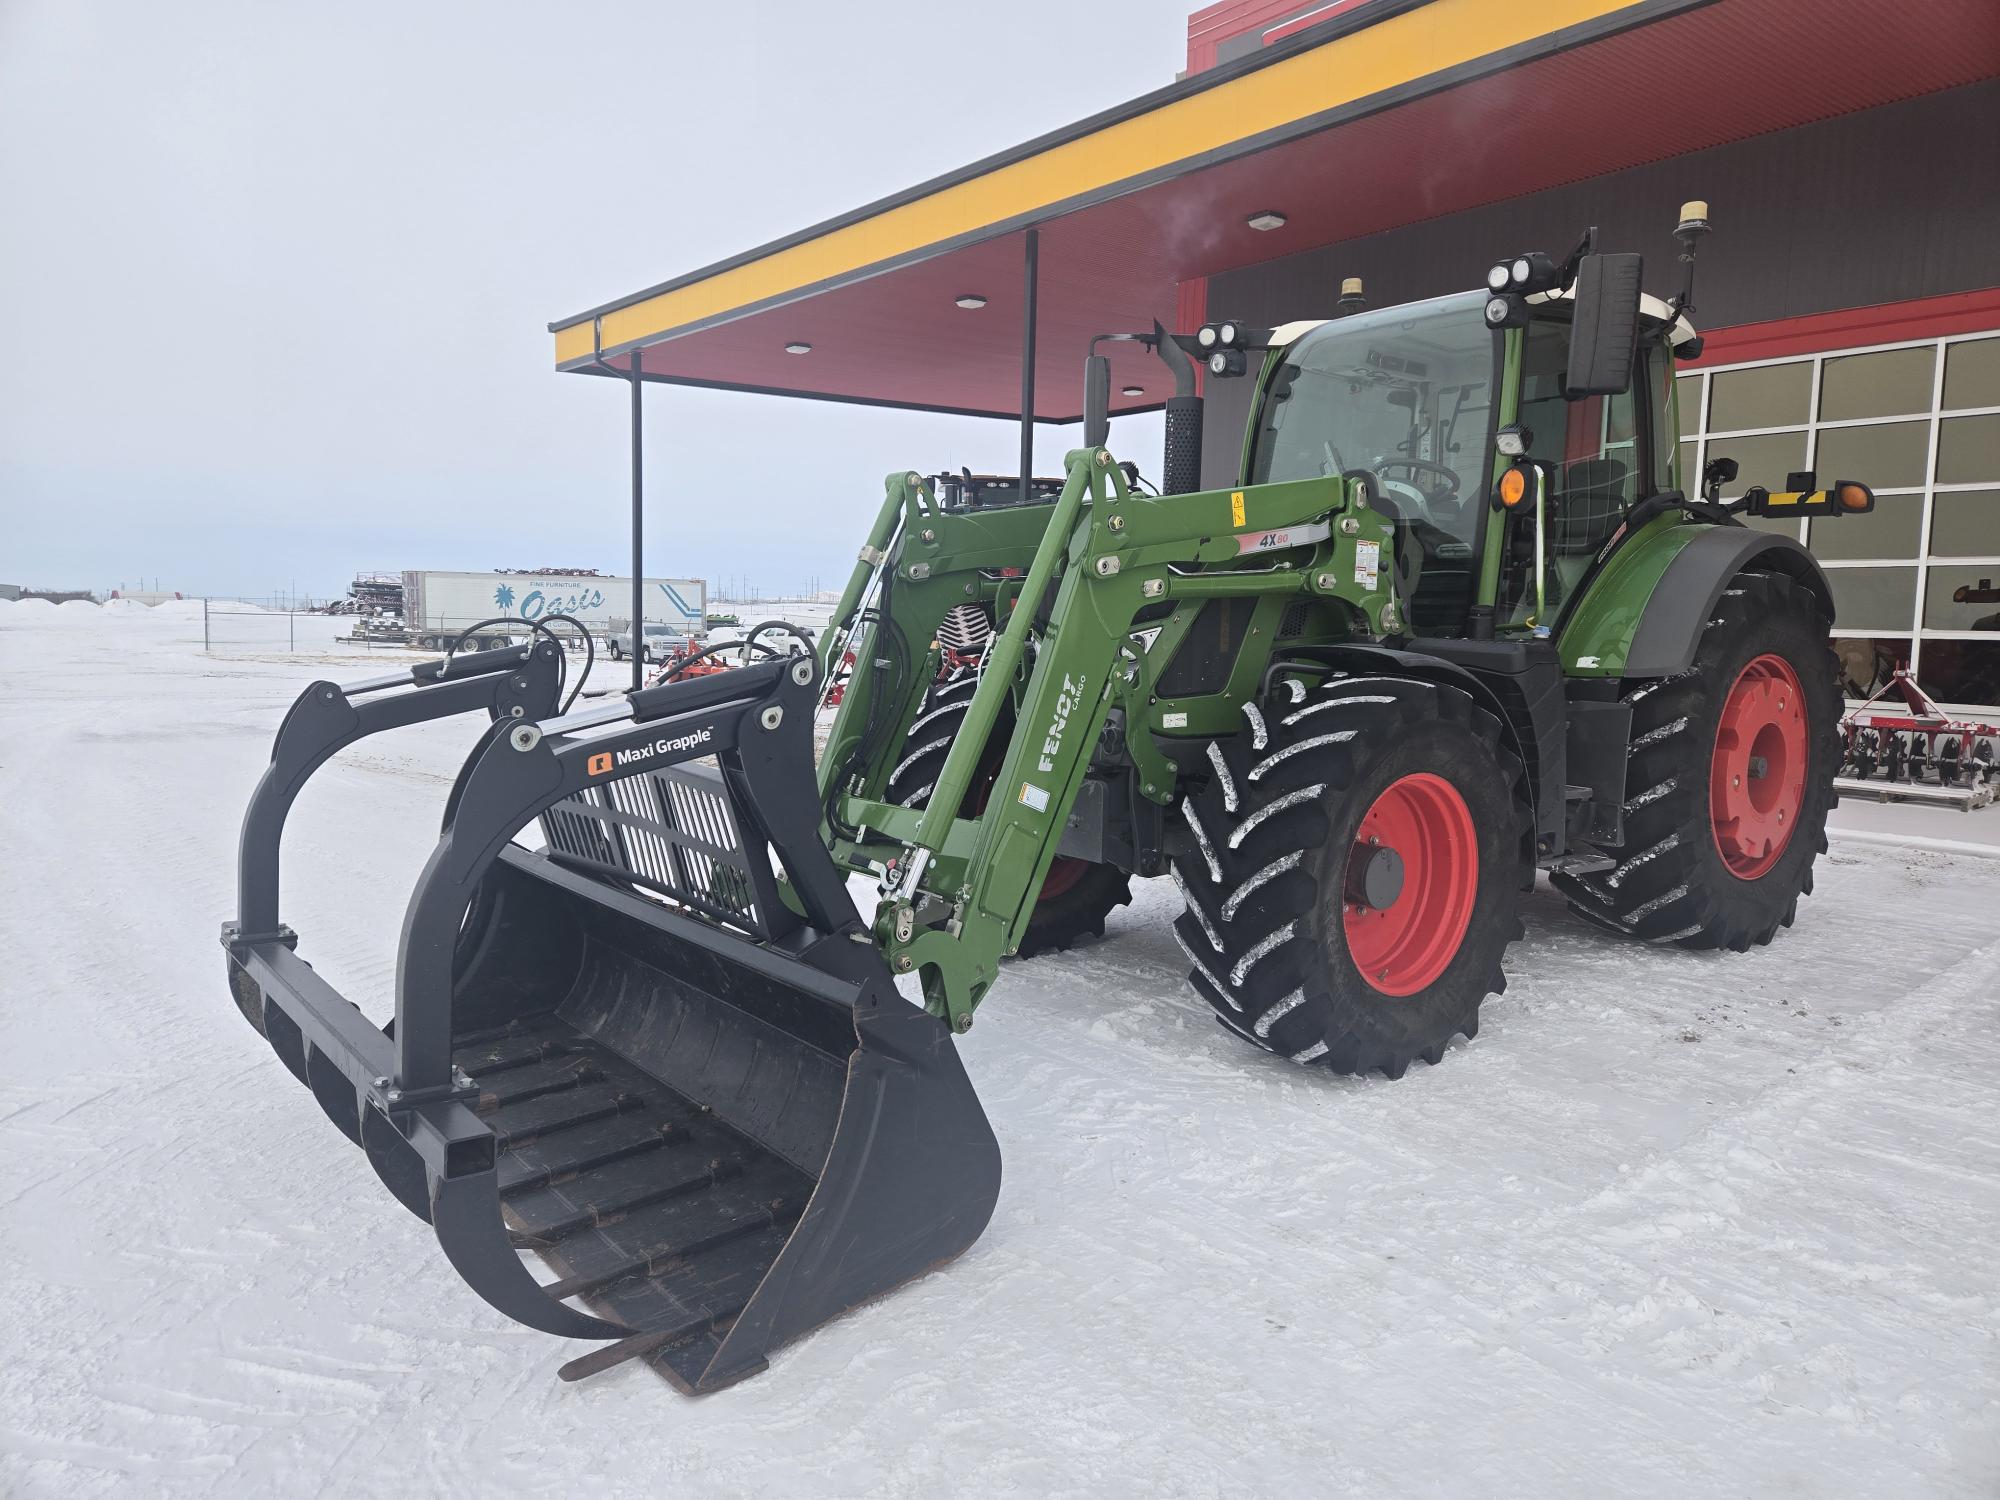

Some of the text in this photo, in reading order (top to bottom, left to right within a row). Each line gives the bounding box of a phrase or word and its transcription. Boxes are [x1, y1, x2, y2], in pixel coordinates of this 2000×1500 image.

[520, 588, 605, 620] Oasis
[1072, 675, 1086, 711] CARGO
[1038, 672, 1076, 772] FENDT
[616, 743, 654, 765] Maxi
